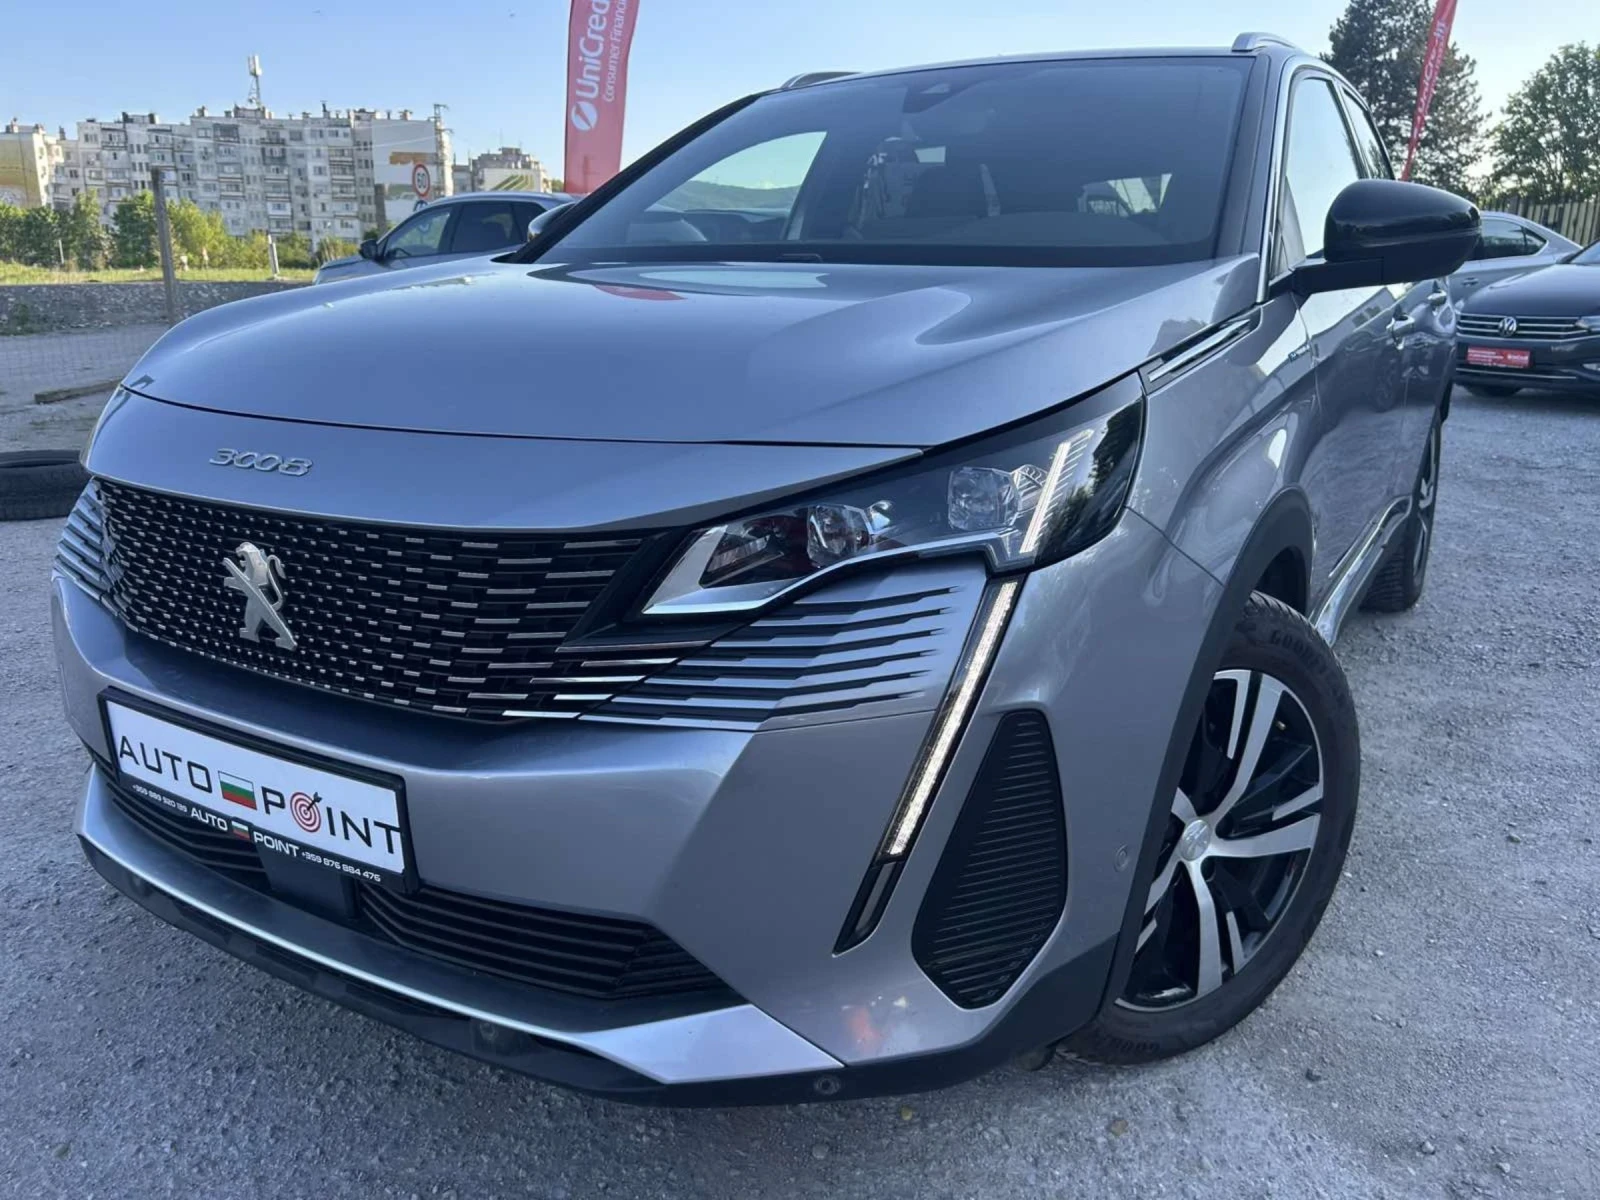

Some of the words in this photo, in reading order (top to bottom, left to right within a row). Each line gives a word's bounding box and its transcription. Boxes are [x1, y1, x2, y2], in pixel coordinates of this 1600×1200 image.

[603, 42, 621, 102] Consumer
[208, 447, 313, 477] 3008
[119, 735, 213, 793] AUTO
[261, 785, 401, 855] POINT
[190, 807, 228, 831] AUTO
[253, 831, 299, 857] POINT
[301, 851, 322, 863] +359
[323, 857, 341, 869] 876
[362, 870, 381, 882] 476
